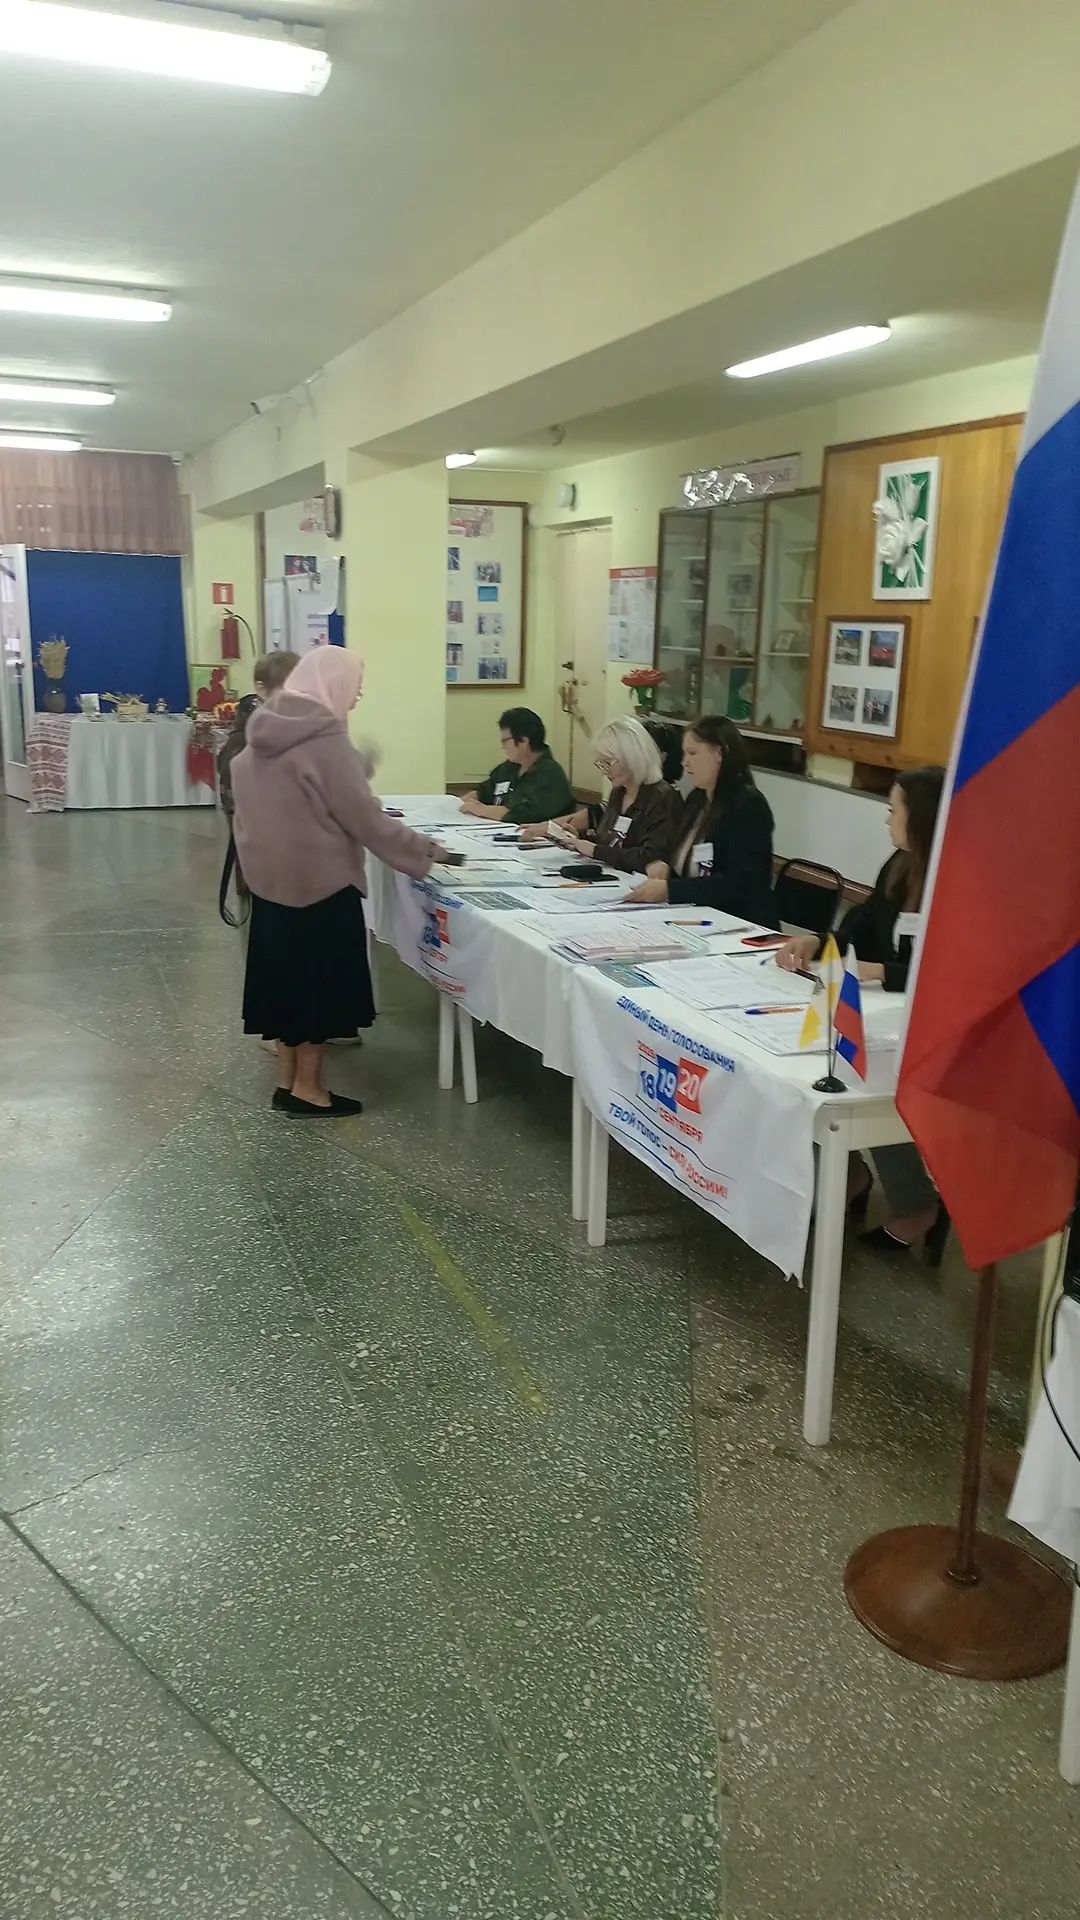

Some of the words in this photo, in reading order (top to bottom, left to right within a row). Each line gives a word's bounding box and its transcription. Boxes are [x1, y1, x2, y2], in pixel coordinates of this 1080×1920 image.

[616, 995, 650, 1024] ЕДИНЫЙ
[648, 1016, 669, 1037] ДЕНЬ
[668, 1029, 735, 1073] ГОЛОСОВАНИЯ
[640, 1070, 656, 1099] 18
[658, 1068, 677, 1098] 19
[678, 1068, 700, 1102] 20
[609, 1103, 636, 1128] ТВОЙ
[637, 1120, 661, 1148] ГОЛОС
[659, 1107, 703, 1143] СЕНТЯБРЯ
